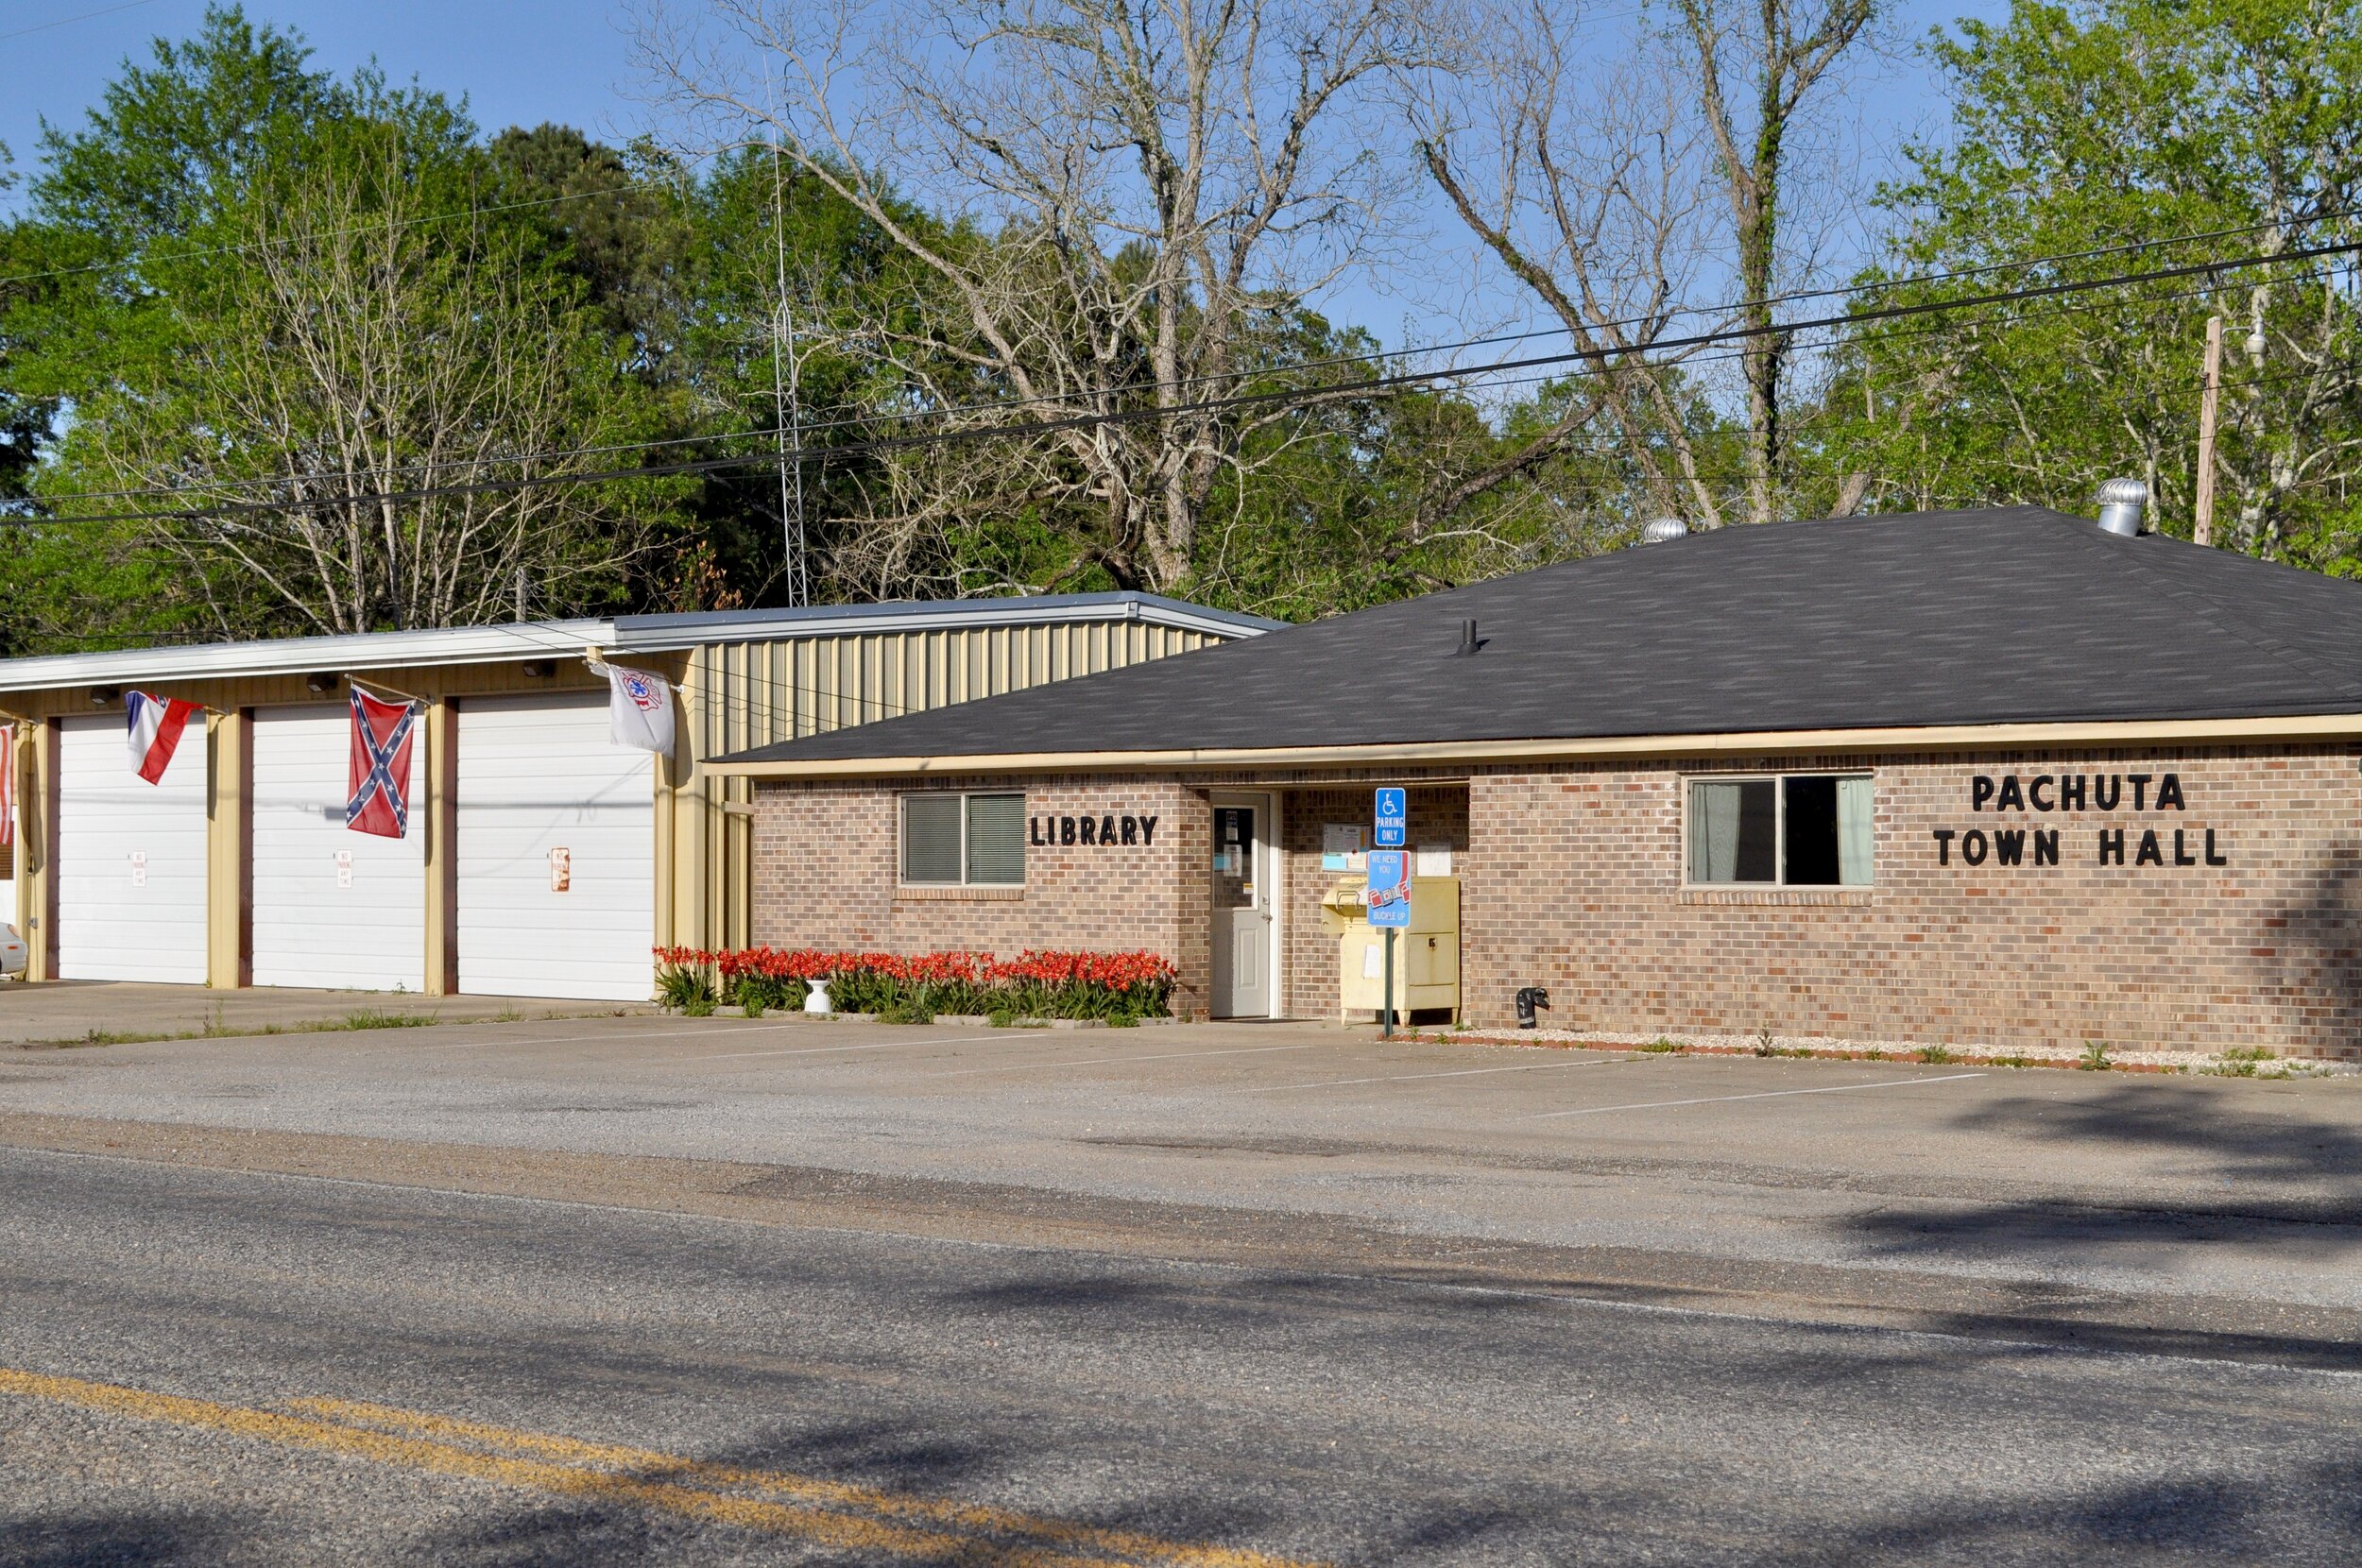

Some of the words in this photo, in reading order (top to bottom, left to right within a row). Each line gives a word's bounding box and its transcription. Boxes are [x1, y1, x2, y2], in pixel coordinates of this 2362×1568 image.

[1972, 773, 2186, 812] PACHUTA
[1377, 817, 1404, 827] PARKING
[1030, 815, 1158, 846] LIBRARY
[1381, 830, 1398, 841] ONLY
[1933, 828, 2060, 867] TOWN
[2098, 828, 2228, 867] HALL
[1372, 855, 1380, 863] WE
[1382, 855, 1398, 863] NEED
[1373, 912, 1395, 921] BUCKLE
[1397, 912, 1406, 921] UP
